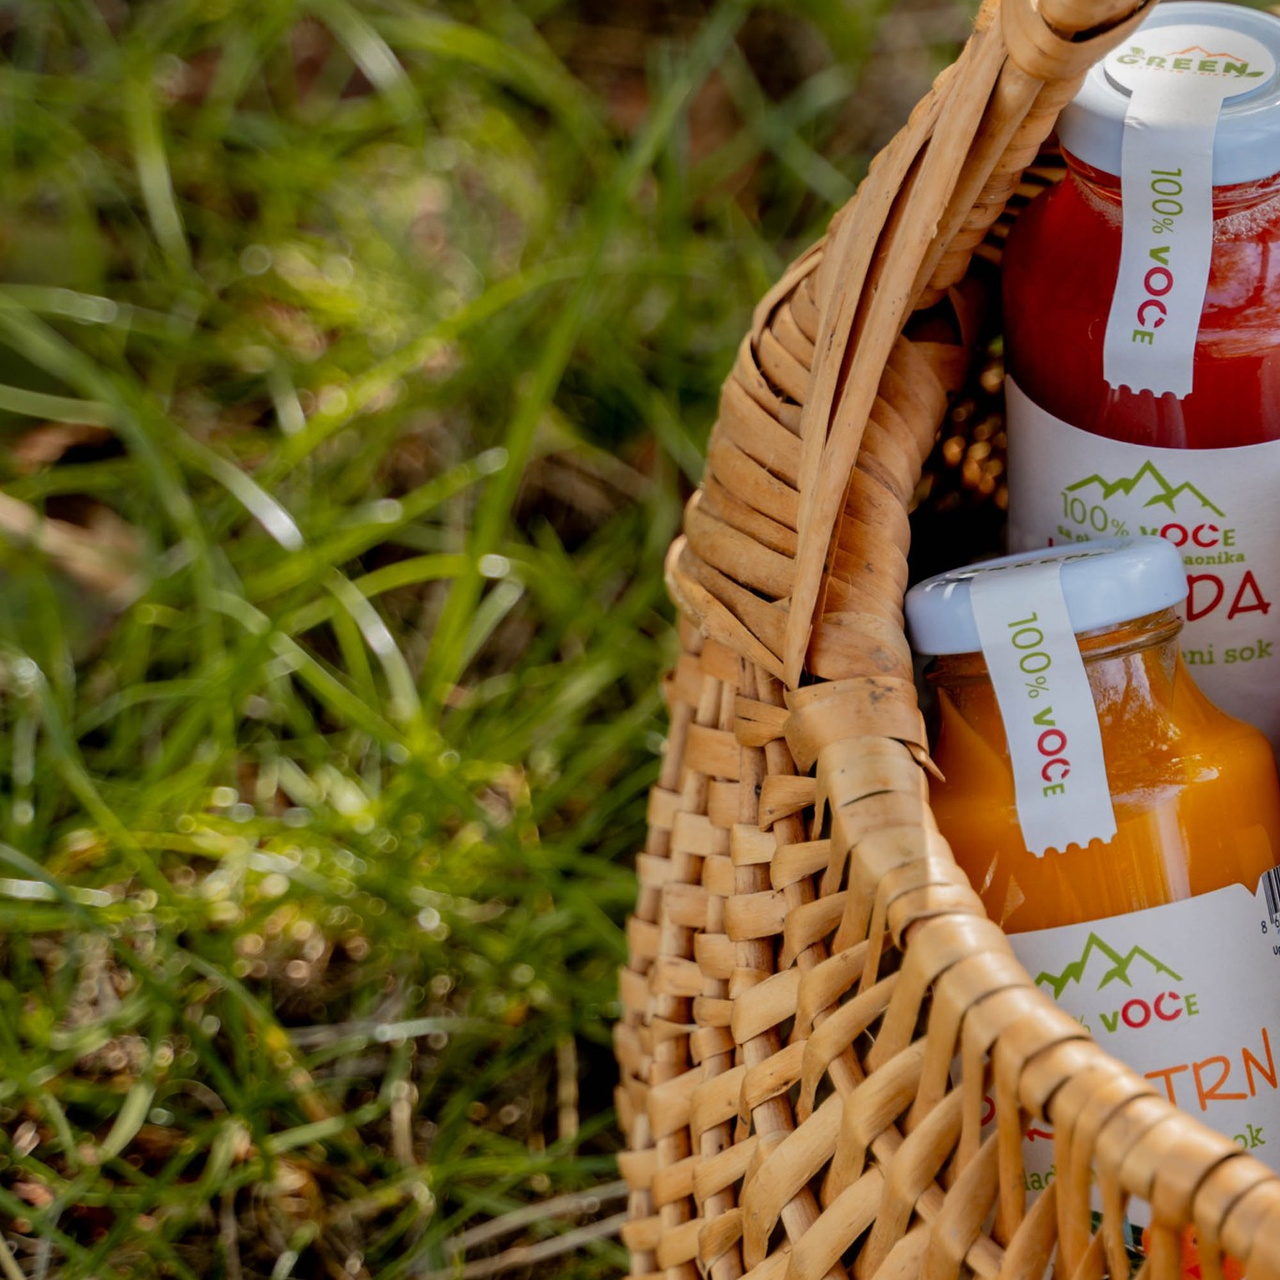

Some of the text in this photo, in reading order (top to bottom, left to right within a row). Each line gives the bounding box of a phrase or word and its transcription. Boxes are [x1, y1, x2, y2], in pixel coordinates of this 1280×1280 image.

[1116, 54, 1249, 77] GREEN
[1151, 168, 1184, 235] 100%
[1008, 612, 1051, 699] 100%
[1224, 639, 1273, 666] sok
[1233, 1124, 1266, 1151] ok
